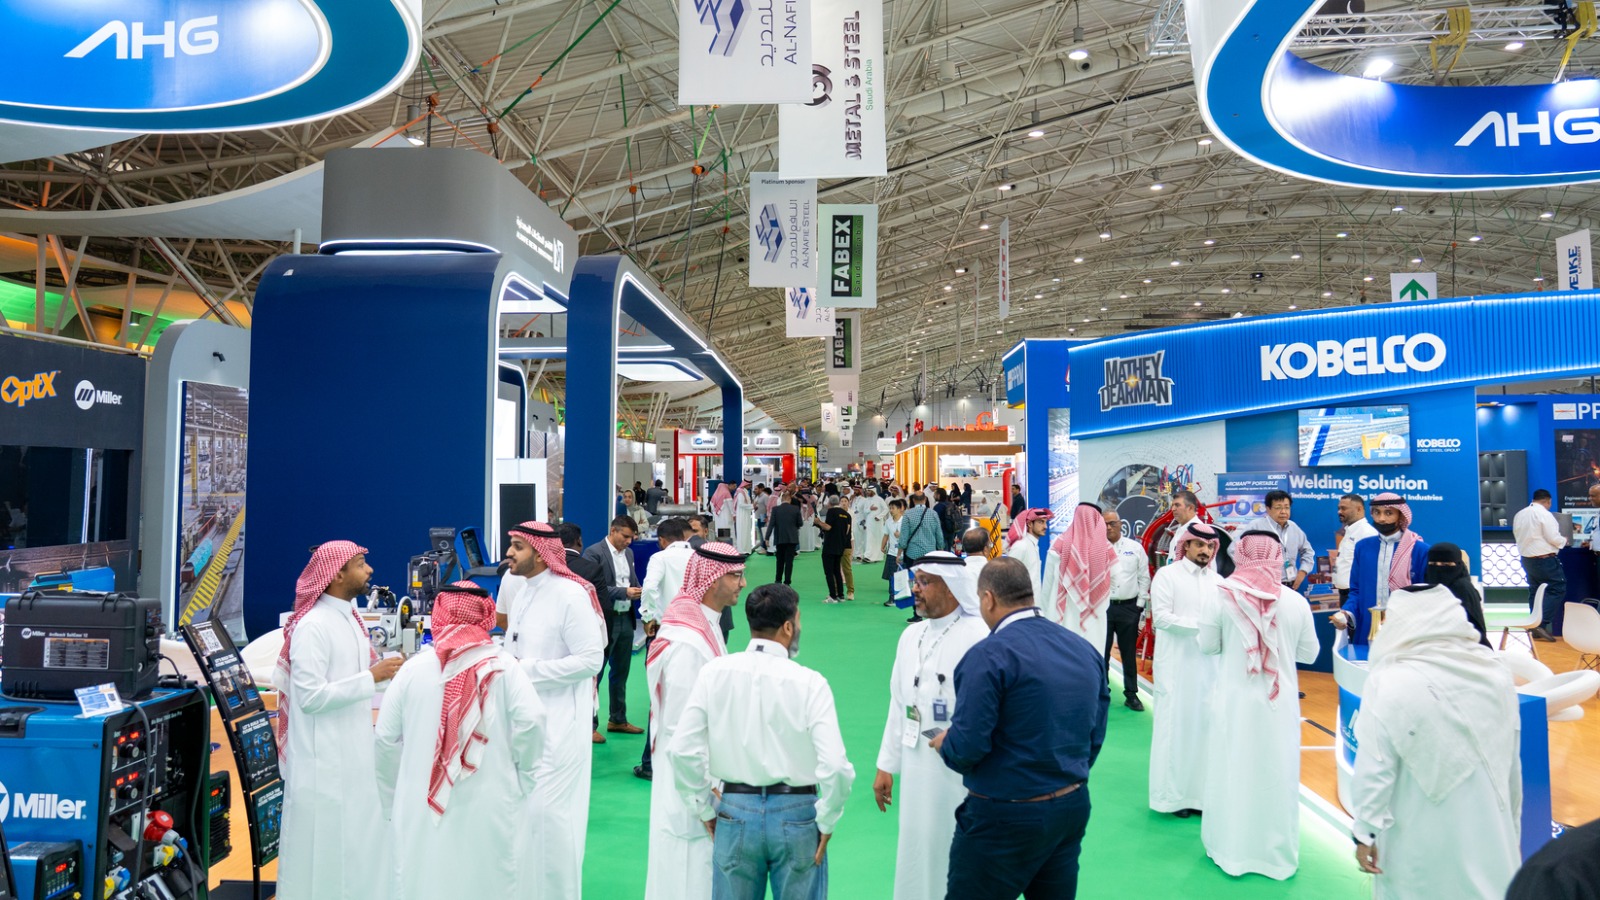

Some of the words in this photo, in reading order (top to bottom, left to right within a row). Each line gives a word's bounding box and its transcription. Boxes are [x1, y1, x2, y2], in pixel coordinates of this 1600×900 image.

[64, 15, 219, 59] AHG
[843, 10, 861, 70] STEEL
[844, 74, 861, 88] &
[865, 59, 873, 86] Arabia
[844, 93, 862, 161] METAL
[1454, 108, 1600, 147] AHG
[785, 178, 806, 187] Sponsor
[802, 200, 810, 227] STEEL
[802, 229, 810, 268] AL-NAFIE
[834, 219, 851, 292] FABEX
[834, 320, 844, 366] FABEX
[1260, 333, 1447, 380] KOBELCO
[1105, 353, 1163, 385] MATHEY
[0, 370, 57, 407] OptX
[96, 390, 122, 405] Miller
[1101, 378, 1170, 410] DEARMAN
[1416, 438, 1461, 448] KOBELCO
[1289, 474, 1354, 493] Welding
[1358, 474, 1428, 490] Solution
[1290, 492, 1330, 501] Technologies
[13, 793, 86, 819] Miller
